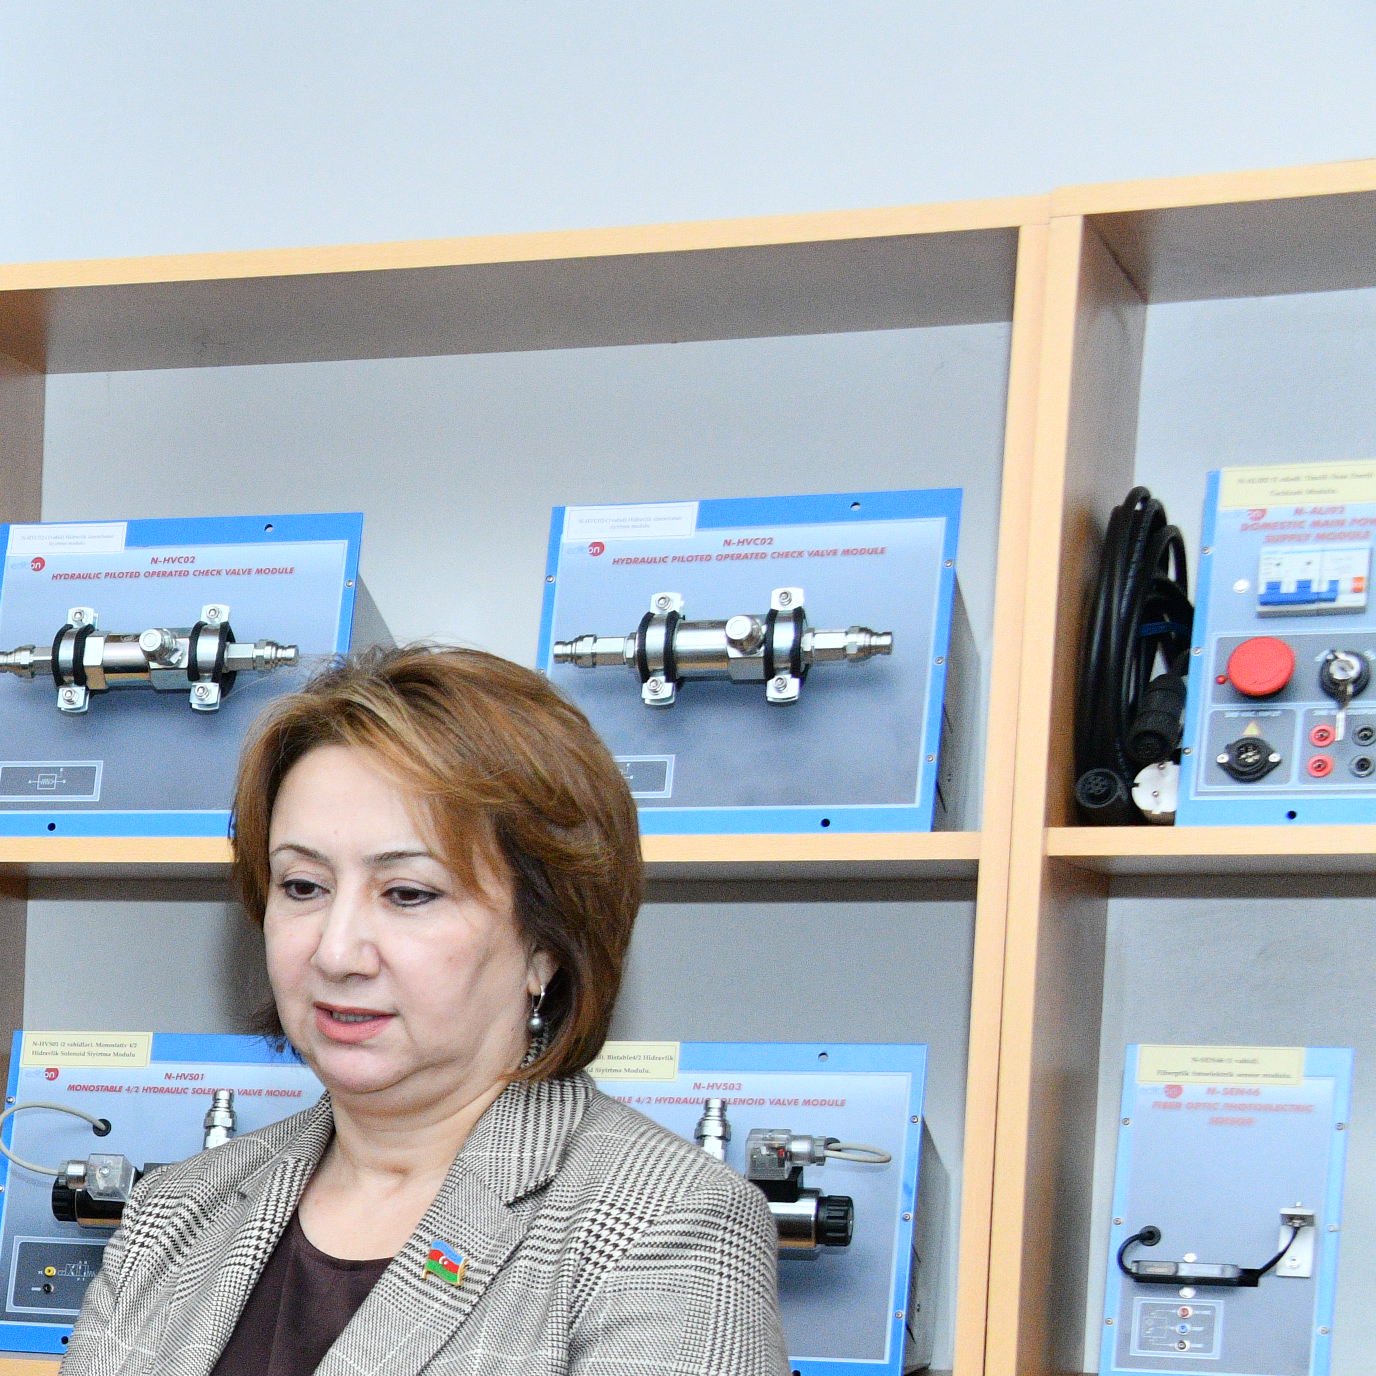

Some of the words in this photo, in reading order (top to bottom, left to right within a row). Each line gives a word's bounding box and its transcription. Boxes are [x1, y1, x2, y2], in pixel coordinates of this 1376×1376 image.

[723, 537, 774, 547] N-HVC02
[150, 556, 196, 565] N-HVC02
[612, 555, 668, 565] HYDRAULIC
[671, 554, 712, 564] PILOTED
[716, 552, 767, 562] OPERATED
[770, 550, 804, 559] CHECK
[807, 549, 838, 557] VALVE
[840, 547, 887, 556] MODULE
[51, 572, 101, 581] HYDRAULIC
[104, 571, 141, 579] PILOTED
[143, 569, 190, 578] OPERATED
[192, 569, 222, 577] CHECK
[225, 568, 253, 576] VALVE
[254, 567, 296, 576] MODULE
[67, 1084, 123, 1093] MONOSTABLE
[125, 1085, 139, 1093] 4/2
[142, 1086, 189, 1095] HYDRAULIC
[265, 1089, 303, 1098] MODULE
[637, 1096, 652, 1104] 4/2
[769, 1098, 799, 1106] VALVE
[801, 1099, 846, 1107] MODULE
